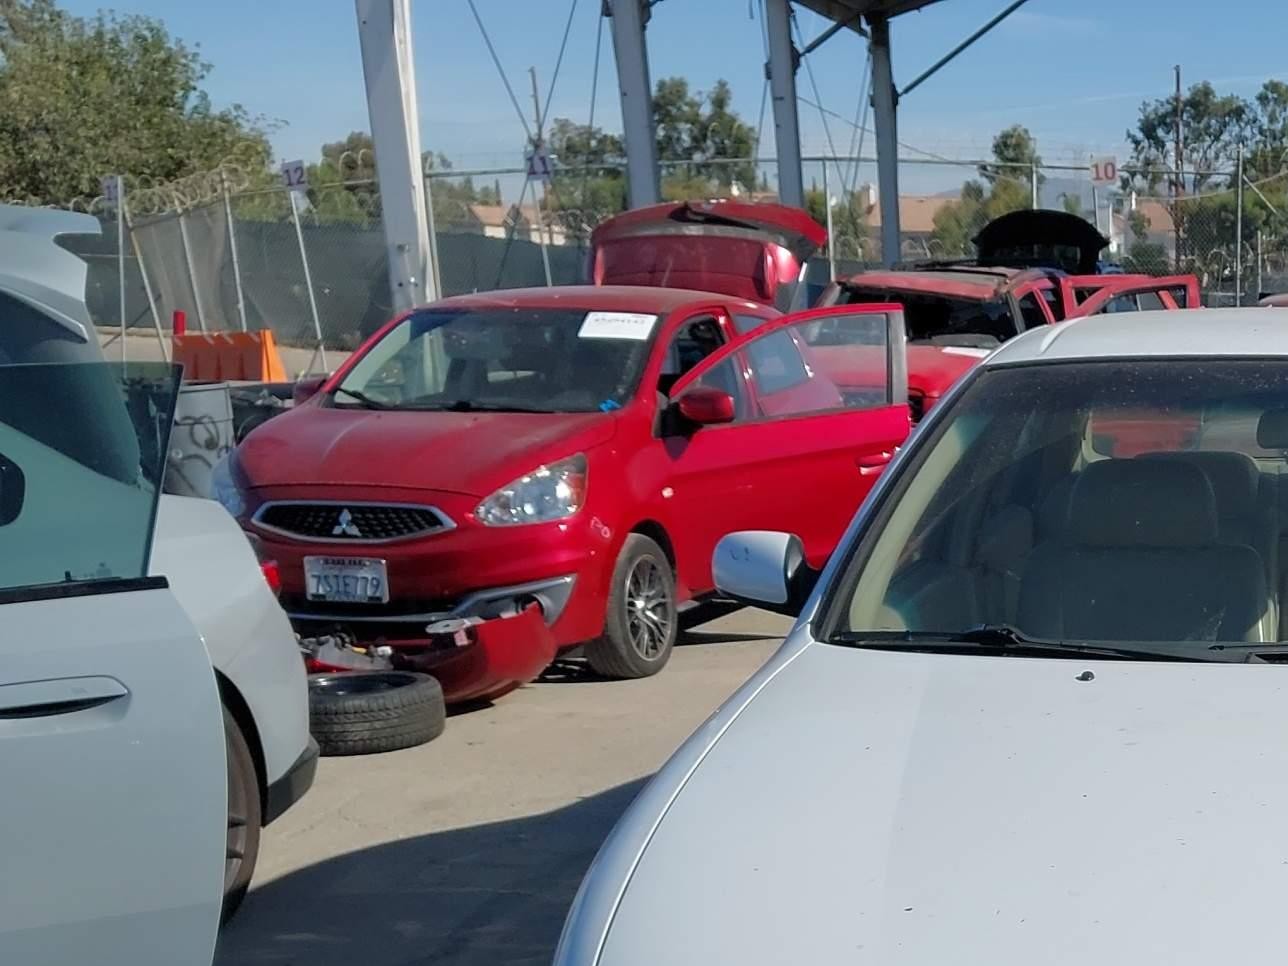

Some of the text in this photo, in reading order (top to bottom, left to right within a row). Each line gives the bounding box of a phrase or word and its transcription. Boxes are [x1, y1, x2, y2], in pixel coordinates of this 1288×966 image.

[526, 156, 551, 176] 11
[1091, 162, 1117, 181] 10
[282, 166, 306, 187] 12
[311, 574, 381, 595] 7SIE779
